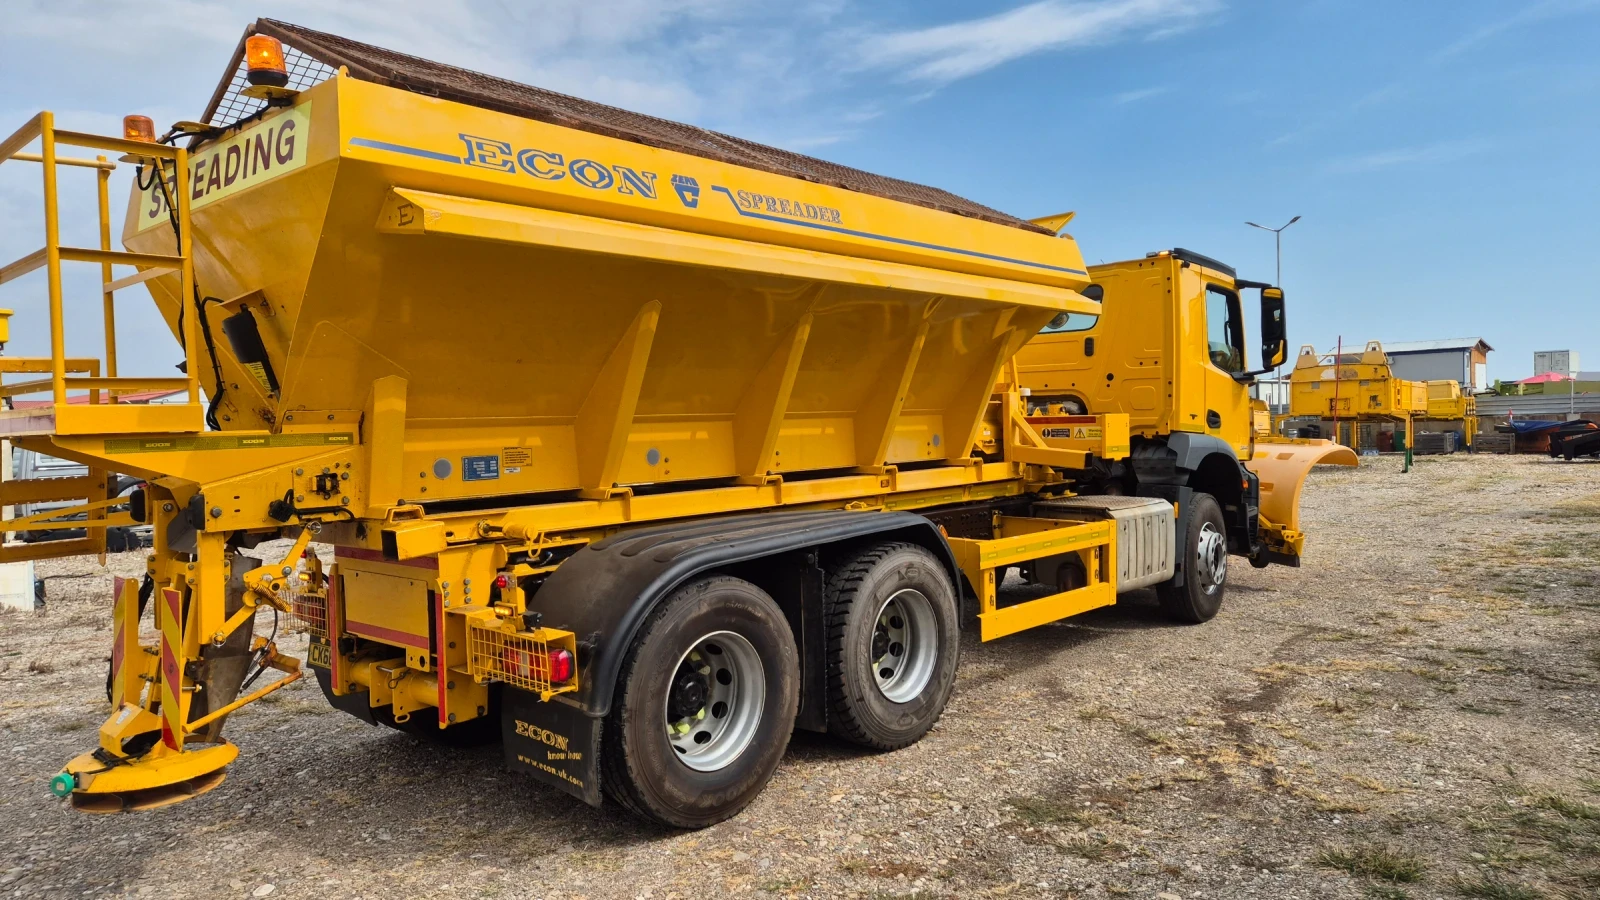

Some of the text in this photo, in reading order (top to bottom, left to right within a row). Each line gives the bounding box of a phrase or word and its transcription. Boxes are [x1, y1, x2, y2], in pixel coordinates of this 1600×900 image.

[149, 119, 297, 219] SPEADING
[459, 133, 658, 199] ECON
[736, 189, 844, 225] SPREADER
[312, 645, 332, 665] CK6
[515, 719, 569, 751] ECON
[517, 754, 584, 788] www.econ.uk.com
[547, 750, 582, 760] know how
